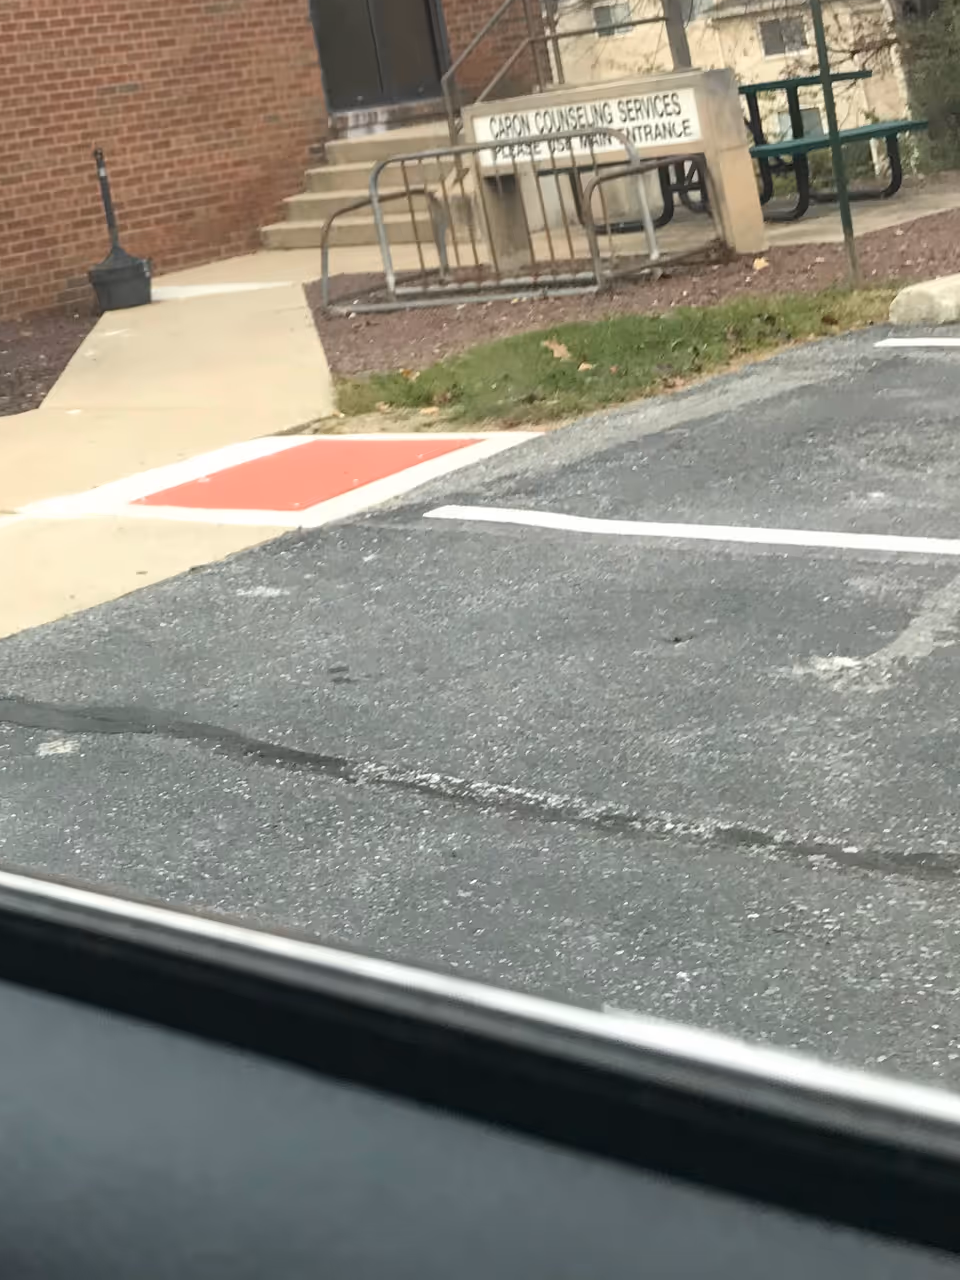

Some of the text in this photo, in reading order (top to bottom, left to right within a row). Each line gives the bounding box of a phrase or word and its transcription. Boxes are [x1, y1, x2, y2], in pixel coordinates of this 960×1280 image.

[489, 92, 682, 140] CARON COUNSELING SERVICES
[494, 141, 542, 161] PLEASE
[579, 132, 612, 149] MAIN
[617, 118, 693, 143] NTRANCE
